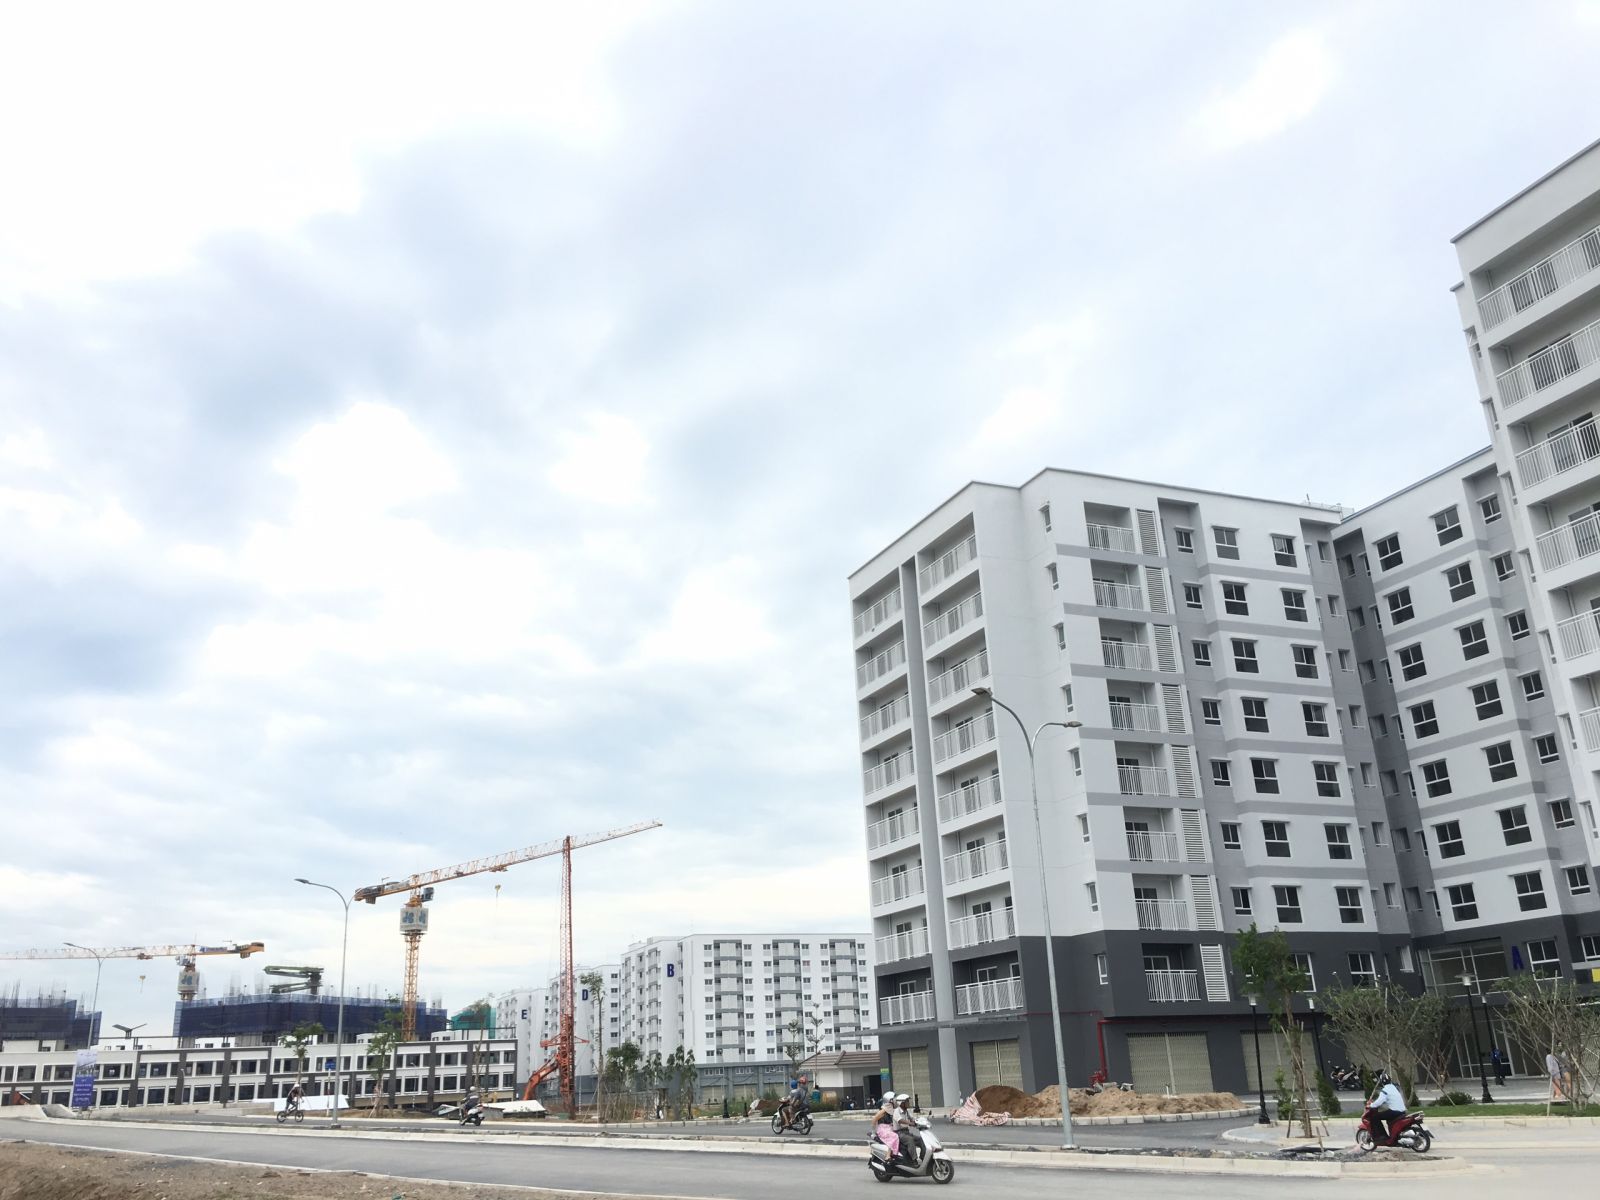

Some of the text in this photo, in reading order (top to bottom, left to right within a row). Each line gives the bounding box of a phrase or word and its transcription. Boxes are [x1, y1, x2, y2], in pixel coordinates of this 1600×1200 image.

[1511, 945, 1524, 970] A
[666, 963, 675, 978] B
[582, 989, 589, 1001] D
[521, 1009, 528, 1020] E
